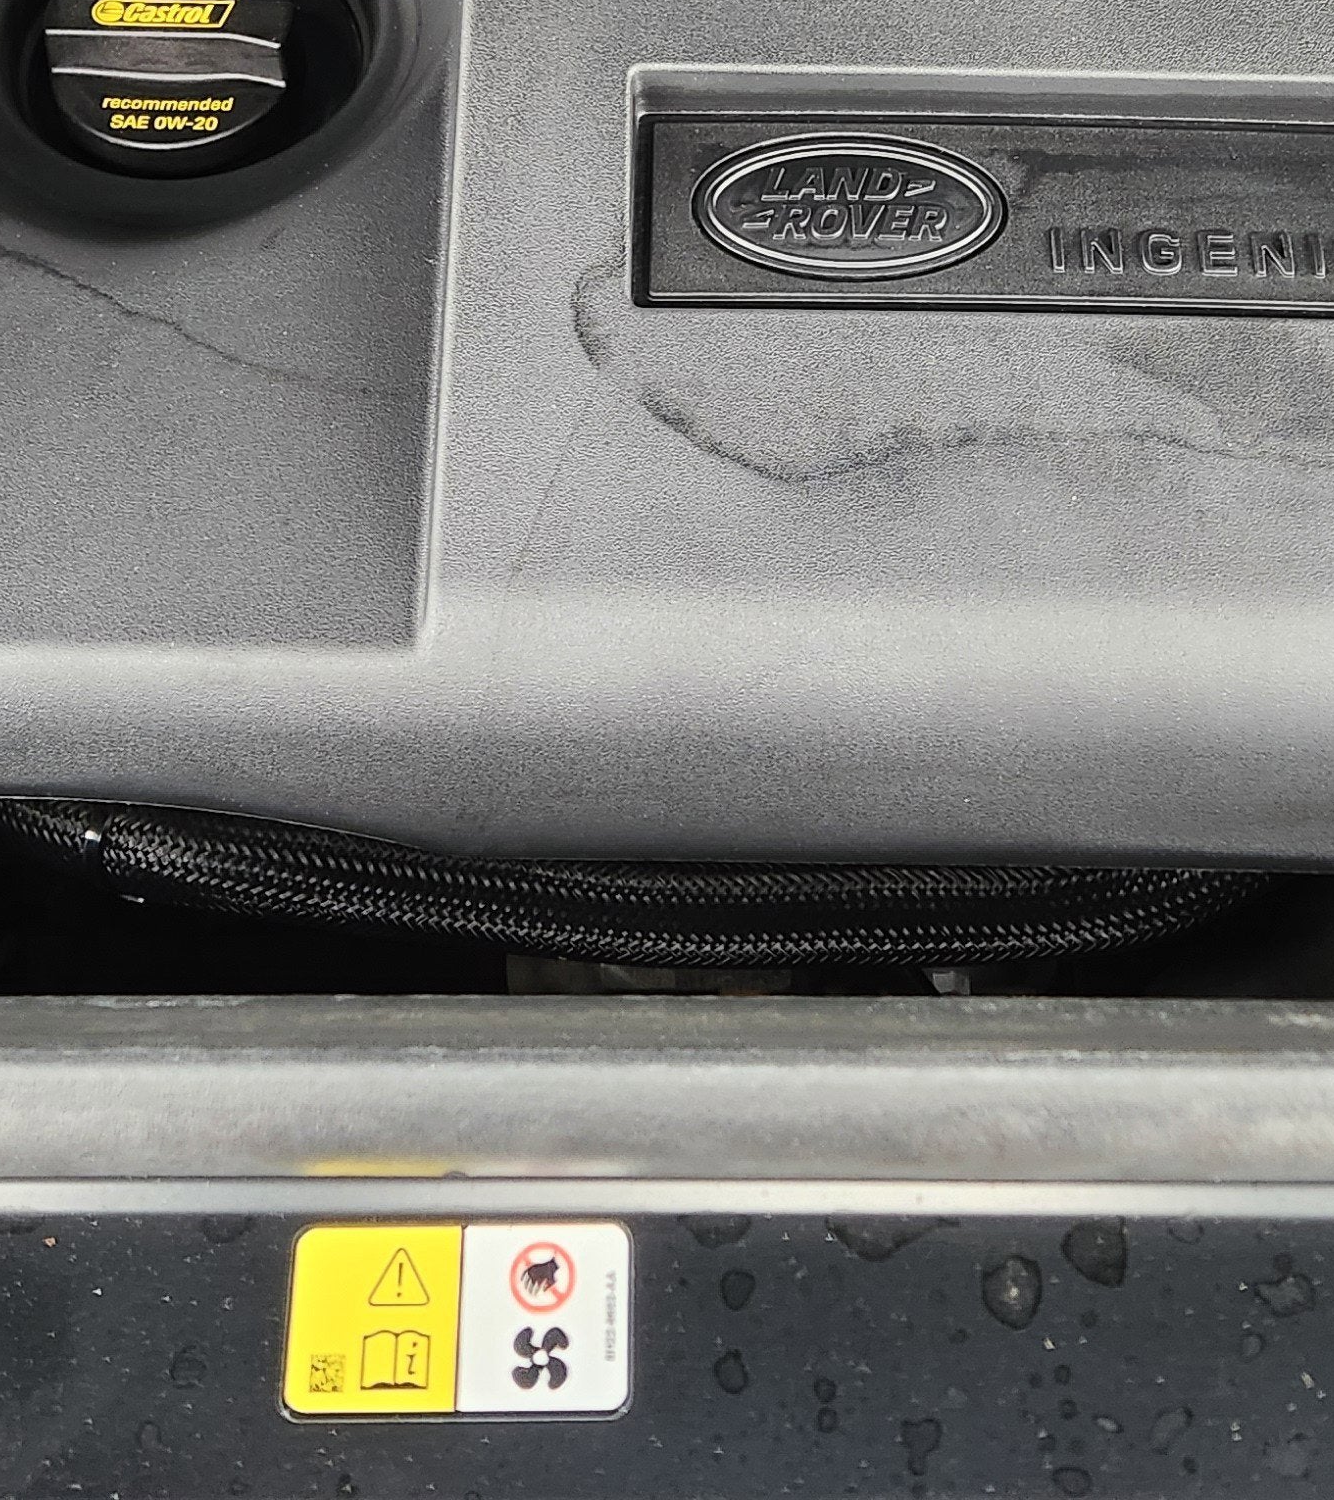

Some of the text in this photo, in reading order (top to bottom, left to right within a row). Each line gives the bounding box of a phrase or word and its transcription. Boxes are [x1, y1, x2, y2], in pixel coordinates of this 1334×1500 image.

[123, 2, 214, 24] Castrol
[102, 97, 234, 111] recommended
[110, 114, 218, 131] SAE 0W-20
[761, 167, 902, 201] LAND
[773, 204, 947, 242] ROVER
